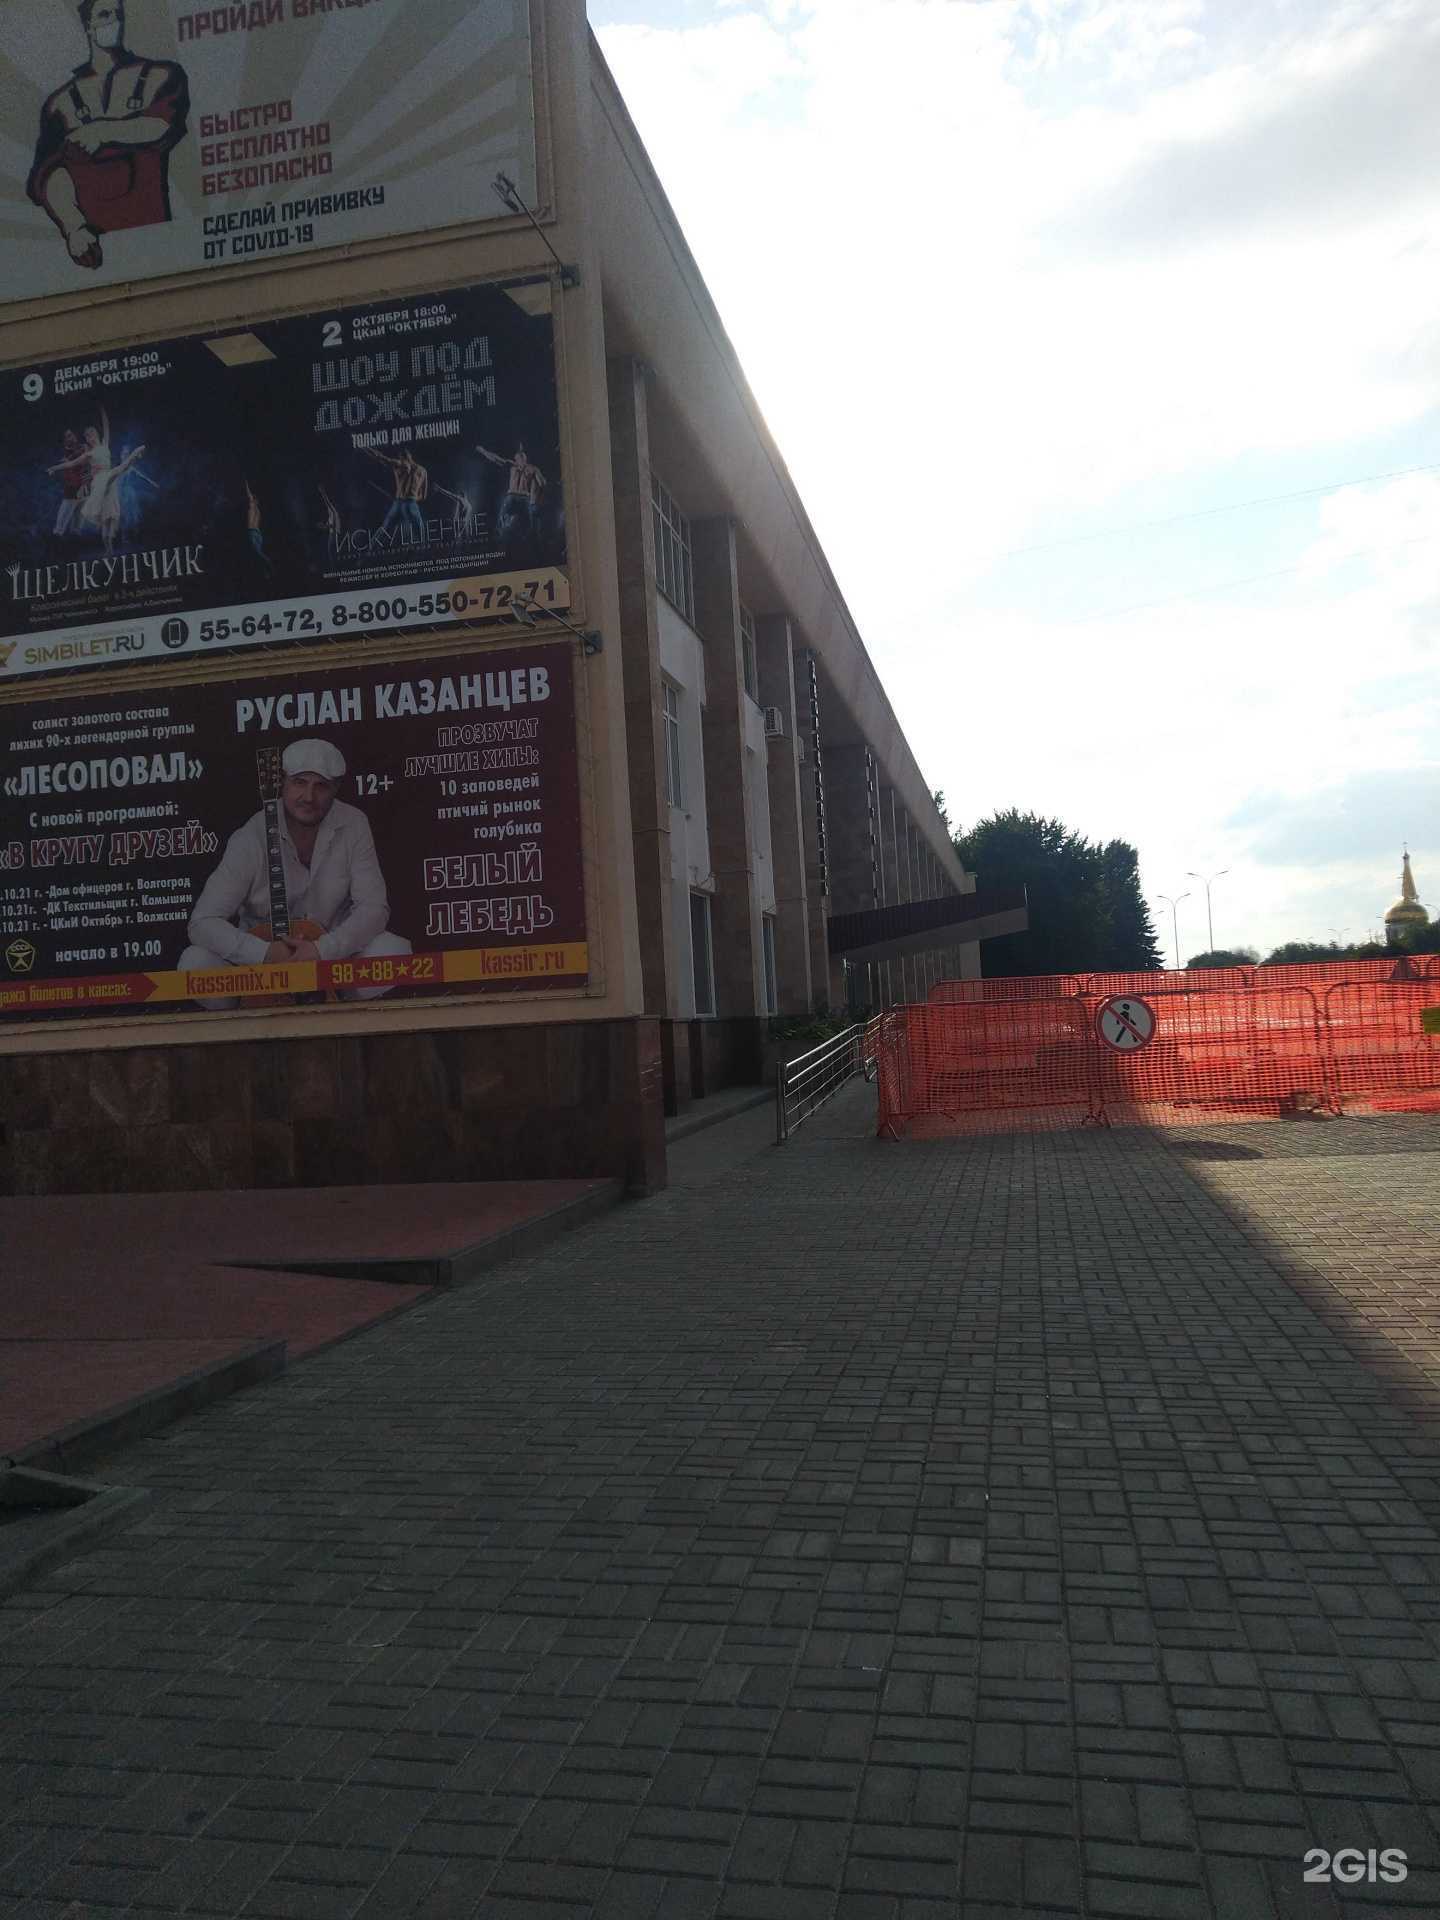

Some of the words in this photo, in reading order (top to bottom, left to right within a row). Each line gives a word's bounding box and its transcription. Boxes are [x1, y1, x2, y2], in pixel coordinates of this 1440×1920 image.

[178, 0, 284, 41] ПРОЙДИ
[200, 100, 292, 137] БЫСТРО
[201, 122, 330, 166] БЕСПЛАТНО
[202, 152, 332, 195] БЕЗОПАСНО
[203, 202, 275, 236] СДЕЛАЙ
[282, 185, 384, 221] ПРИВИВКУ
[204, 239, 226, 259] ОТ
[232, 223, 313, 254] COVID-19
[352, 309, 409, 328] ОКТЯБРЯ
[414, 304, 446, 318] 18:00
[389, 313, 457, 332] "ОКТЯБРЬ"
[321, 320, 343, 347] 2
[54, 358, 118, 382] ДЕКАБРЯ
[122, 352, 159, 367] 19:00
[97, 362, 172, 384] "ОКТЯБРЬ"
[312, 350, 400, 392] ШОУ
[410, 336, 493, 377] ПОД
[22, 373, 44, 401] 9
[314, 373, 496, 432] ДОЖДЁМ
[352, 431, 388, 448] ТОЛЬКО
[391, 426, 412, 444] ДЛЯ
[415, 419, 460, 440] ЖЕНЩИН
[335, 512, 488, 552] ИСКУШЕНИЕ
[8, 544, 205, 601] ЩЕЛКУНЧИК
[200, 609, 322, 641] 55-64-72,
[332, 580, 555, 626] 8-800-550-7271
[25, 633, 145, 665] SIMBILET.RU
[236, 687, 362, 733] РУСЛАН
[375, 666, 550, 719] КАЗАНЦЕВ
[32, 718, 70, 730] солист
[72, 711, 122, 727] золотого
[126, 707, 169, 720] состава
[438, 717, 539, 747] ПРОЗВУЧАТ
[10, 739, 43, 751] лихих
[46, 733, 71, 748] 90-х
[74, 726, 149, 745] легендарной
[152, 723, 195, 739] группы
[4, 752, 203, 796] «ЛЕСОПОВАЛ»
[404, 751, 479, 777] ЛУЧШИЕ
[482, 746, 540, 769] ХИТЫ:
[355, 773, 394, 796] 12+
[440, 779, 457, 796] 10
[462, 772, 540, 794] заповедей
[30, 812, 38, 827] С
[42, 809, 83, 826] новой
[88, 801, 179, 825] программой:
[437, 800, 488, 819] птичий
[493, 798, 541, 818] рынок
[31, 835, 104, 867] КРУГУ
[109, 819, 219, 866] ДРУЗЕЙ»
[473, 819, 542, 840] голубика
[424, 842, 544, 891] БЕЛЫЙ
[73, 881, 123, 896] офицеров
[137, 877, 191, 890] Волгоград
[63, 899, 128, 912] Текстильщик
[141, 893, 192, 906] Камышин
[426, 895, 553, 936] ЛЕБЕДЬ
[81, 914, 123, 928] Октябрь
[137, 909, 188, 923] Волжский
[55, 948, 106, 962] начало
[110, 946, 118, 959] в
[123, 940, 161, 957] 19.00
[480, 949, 564, 975] kassir.ru
[77, 986, 84, 999] в
[186, 968, 288, 995] kassamix.ru
